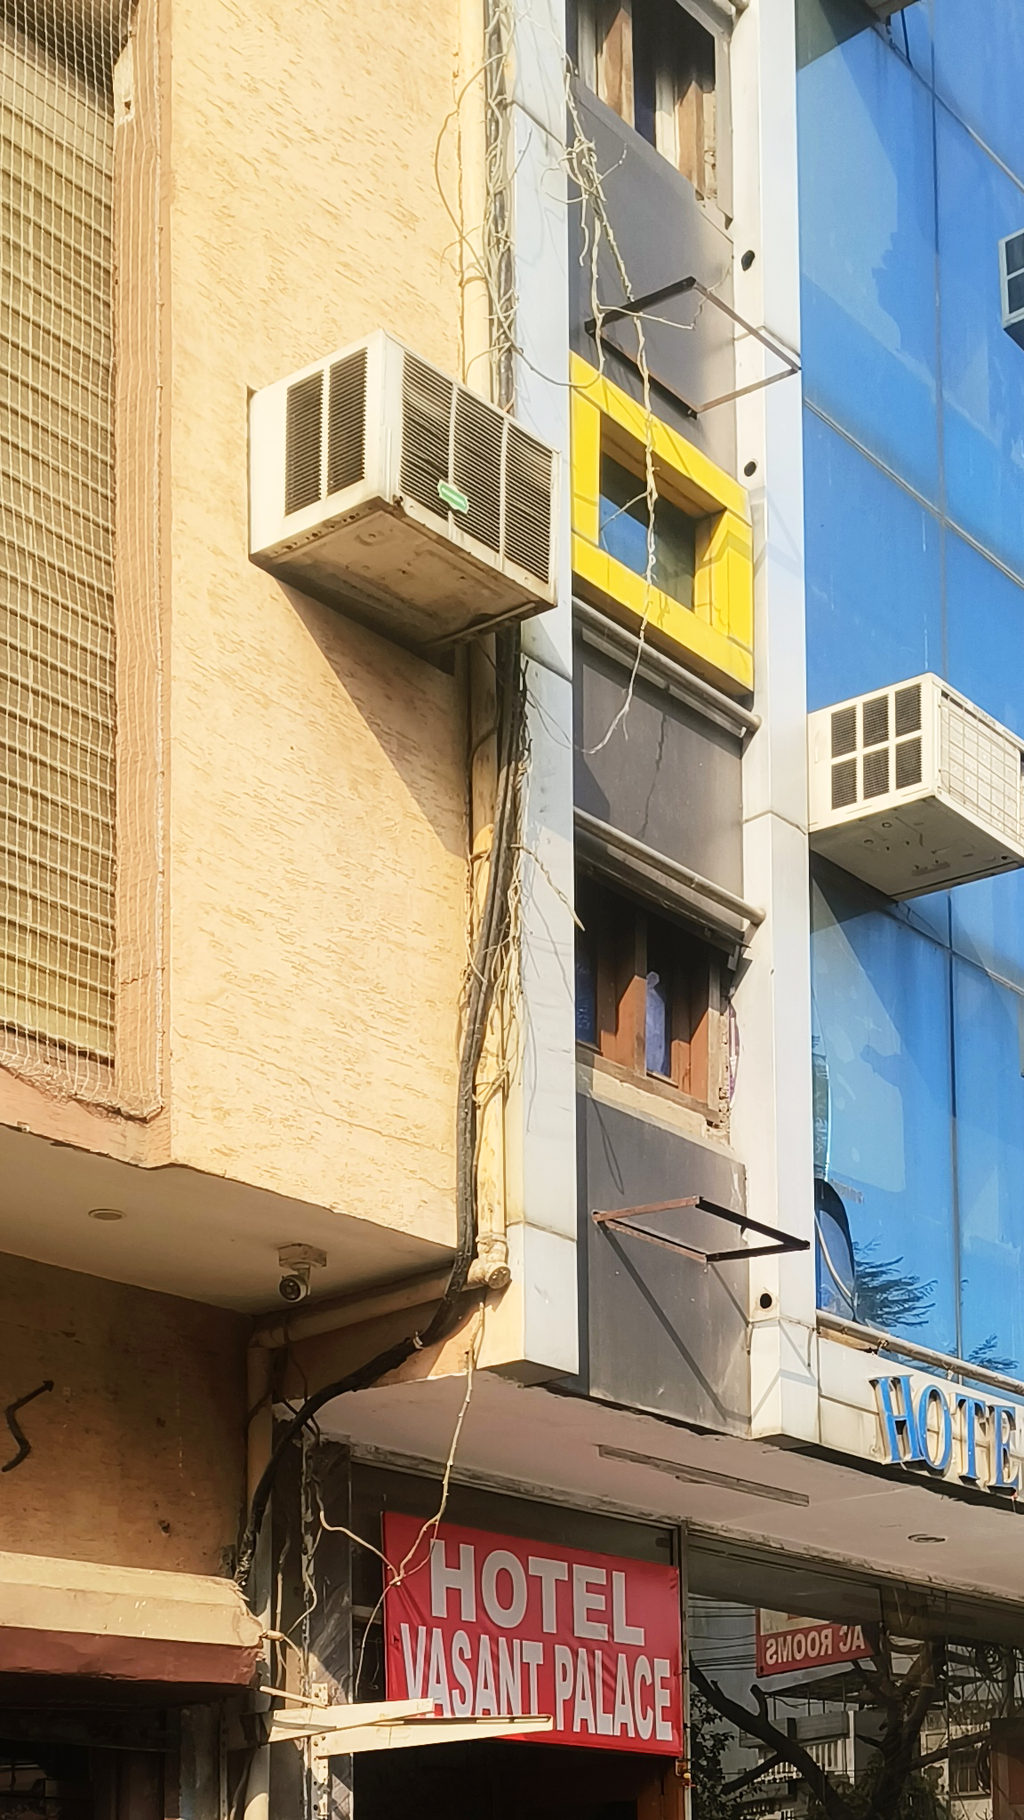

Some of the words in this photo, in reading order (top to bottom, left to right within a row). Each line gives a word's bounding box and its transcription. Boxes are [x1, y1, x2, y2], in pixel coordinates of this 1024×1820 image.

[430, 1538, 645, 1646] HOTEL
[400, 1623, 544, 1717] VASANT
[554, 1644, 673, 1742] PALACE
